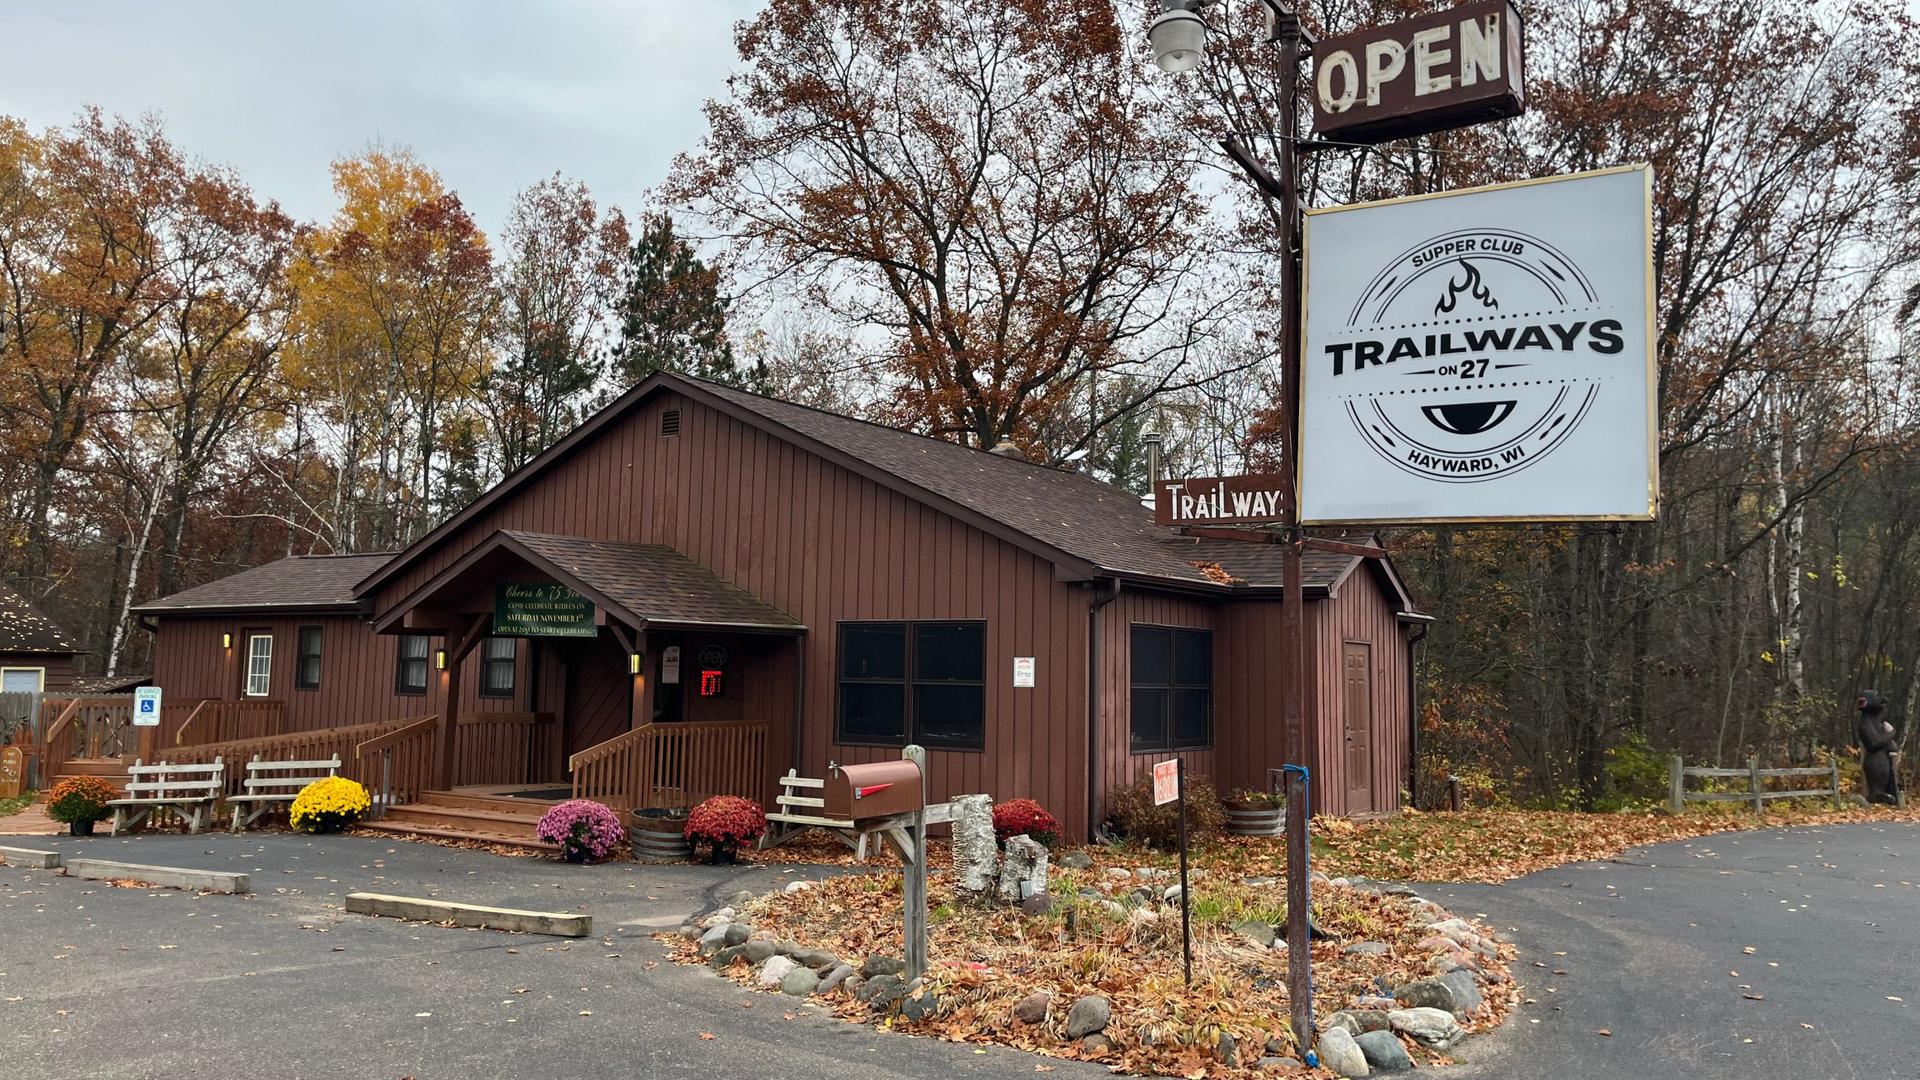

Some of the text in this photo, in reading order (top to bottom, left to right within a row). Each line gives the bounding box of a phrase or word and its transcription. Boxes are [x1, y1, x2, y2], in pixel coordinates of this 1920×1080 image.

[1317, 12, 1501, 114] OPEN
[1412, 238, 1524, 267] SUPPER CLUB
[1325, 319, 1625, 377] TRAILWAYS
[1438, 359, 1490, 379] ON 27
[1408, 445, 1525, 472] HAYWARD, WI
[550, 586, 562, 601] 75
[540, 614, 575, 622] NOVEMBER
